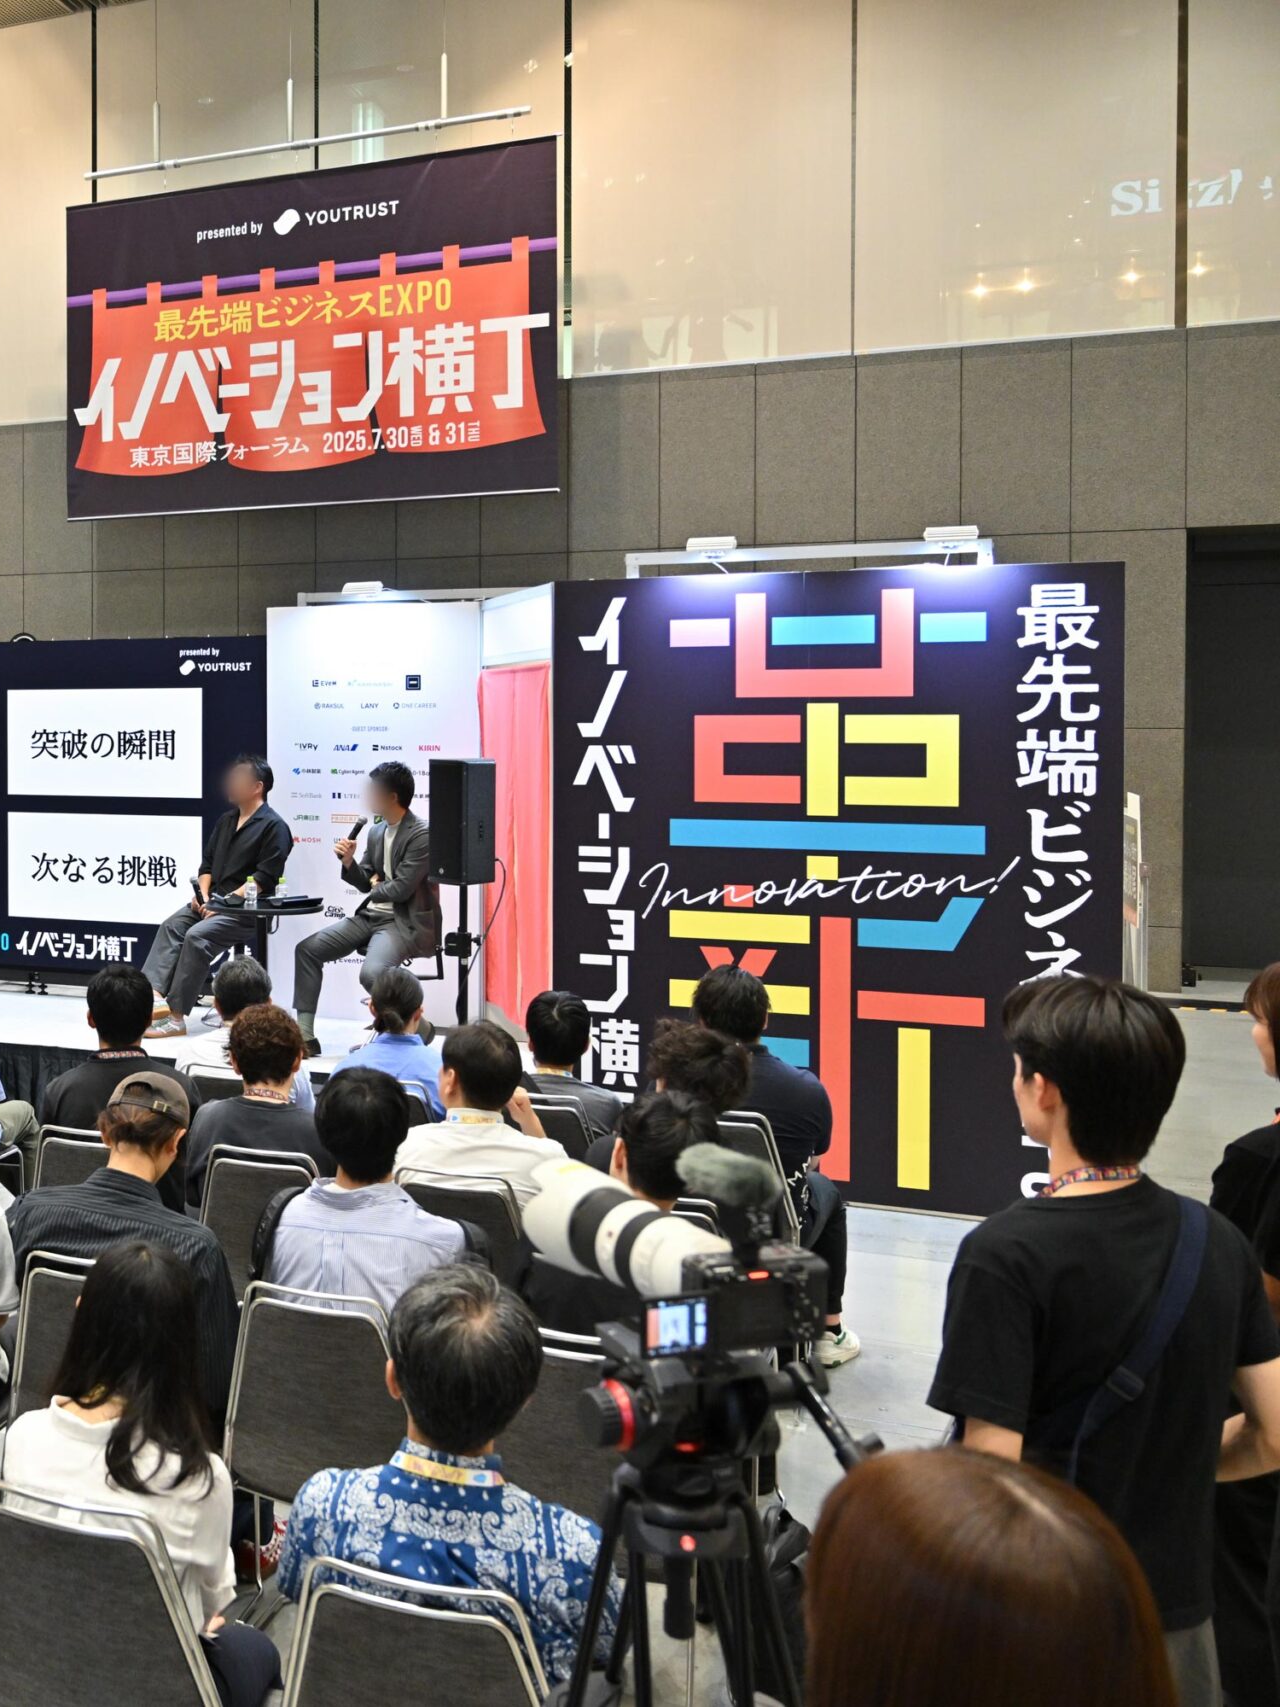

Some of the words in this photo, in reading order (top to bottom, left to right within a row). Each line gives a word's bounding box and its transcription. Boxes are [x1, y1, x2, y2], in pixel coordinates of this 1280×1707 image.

[305, 200, 400, 226] YOUTRUST
[196, 222, 248, 244] presented
[250, 222, 263, 236] by
[153, 278, 452, 342] 最先端ビジネスEXPO
[73, 312, 550, 442] イノベーション横丁
[129, 437, 309, 468] 東京国際フォーラム
[323, 426, 409, 454] 2025.7.30
[410, 425, 423, 447] WED
[428, 423, 440, 446] &
[445, 422, 465, 445] 31
[468, 420, 480, 442] THU
[179, 648, 211, 658] presented
[211, 647, 220, 657] by
[198, 662, 252, 672] YOUTRUST
[31, 728, 176, 761] 突破の瞬間
[573, 596, 640, 1104] イノベーション横
[31, 852, 177, 889] 次なる挑戦
[639, 855, 1020, 919] Innovation!
[15, 930, 138, 962] イノベーション横丁
